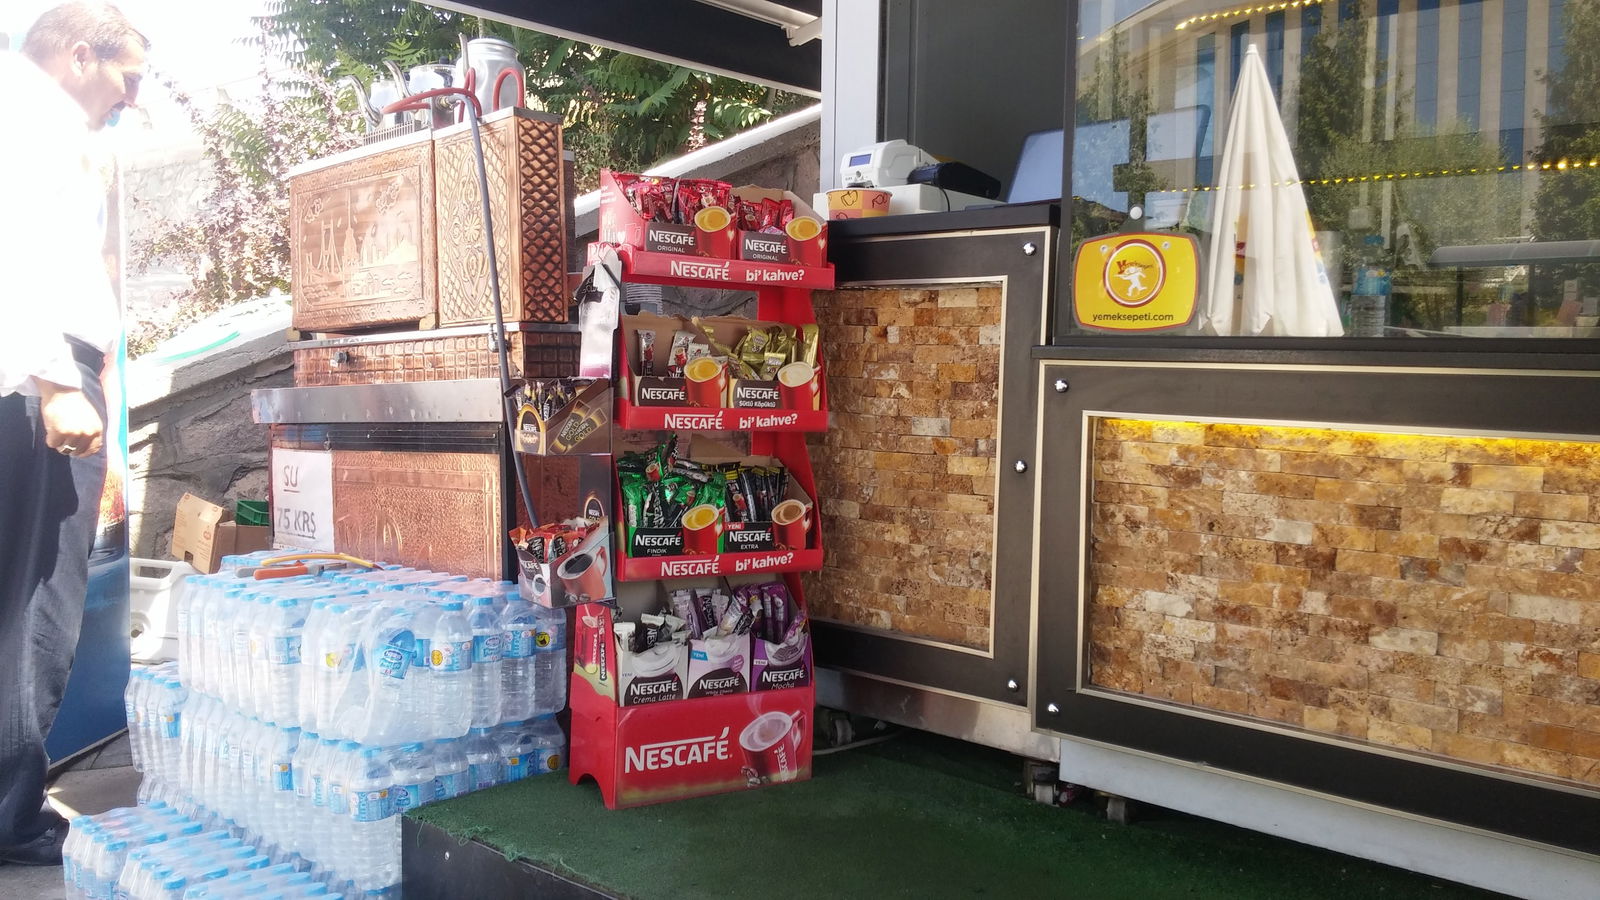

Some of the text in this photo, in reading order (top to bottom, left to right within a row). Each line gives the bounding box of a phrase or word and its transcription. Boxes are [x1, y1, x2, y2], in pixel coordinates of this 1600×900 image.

[657, 245, 685, 254] ORIGINAL
[753, 253, 779, 262] ORIGINAL
[763, 269, 805, 282] kahve?
[1092, 312, 1174, 323] yemeksepeti.com
[756, 413, 798, 428] kahve?
[283, 465, 299, 487] SU
[277, 508, 291, 530] 75
[752, 552, 794, 570] kahve?
[771, 682, 795, 690] Mocha
[633, 693, 676, 704] Crema Latte
[625, 726, 733, 774] NESCAFÉ
